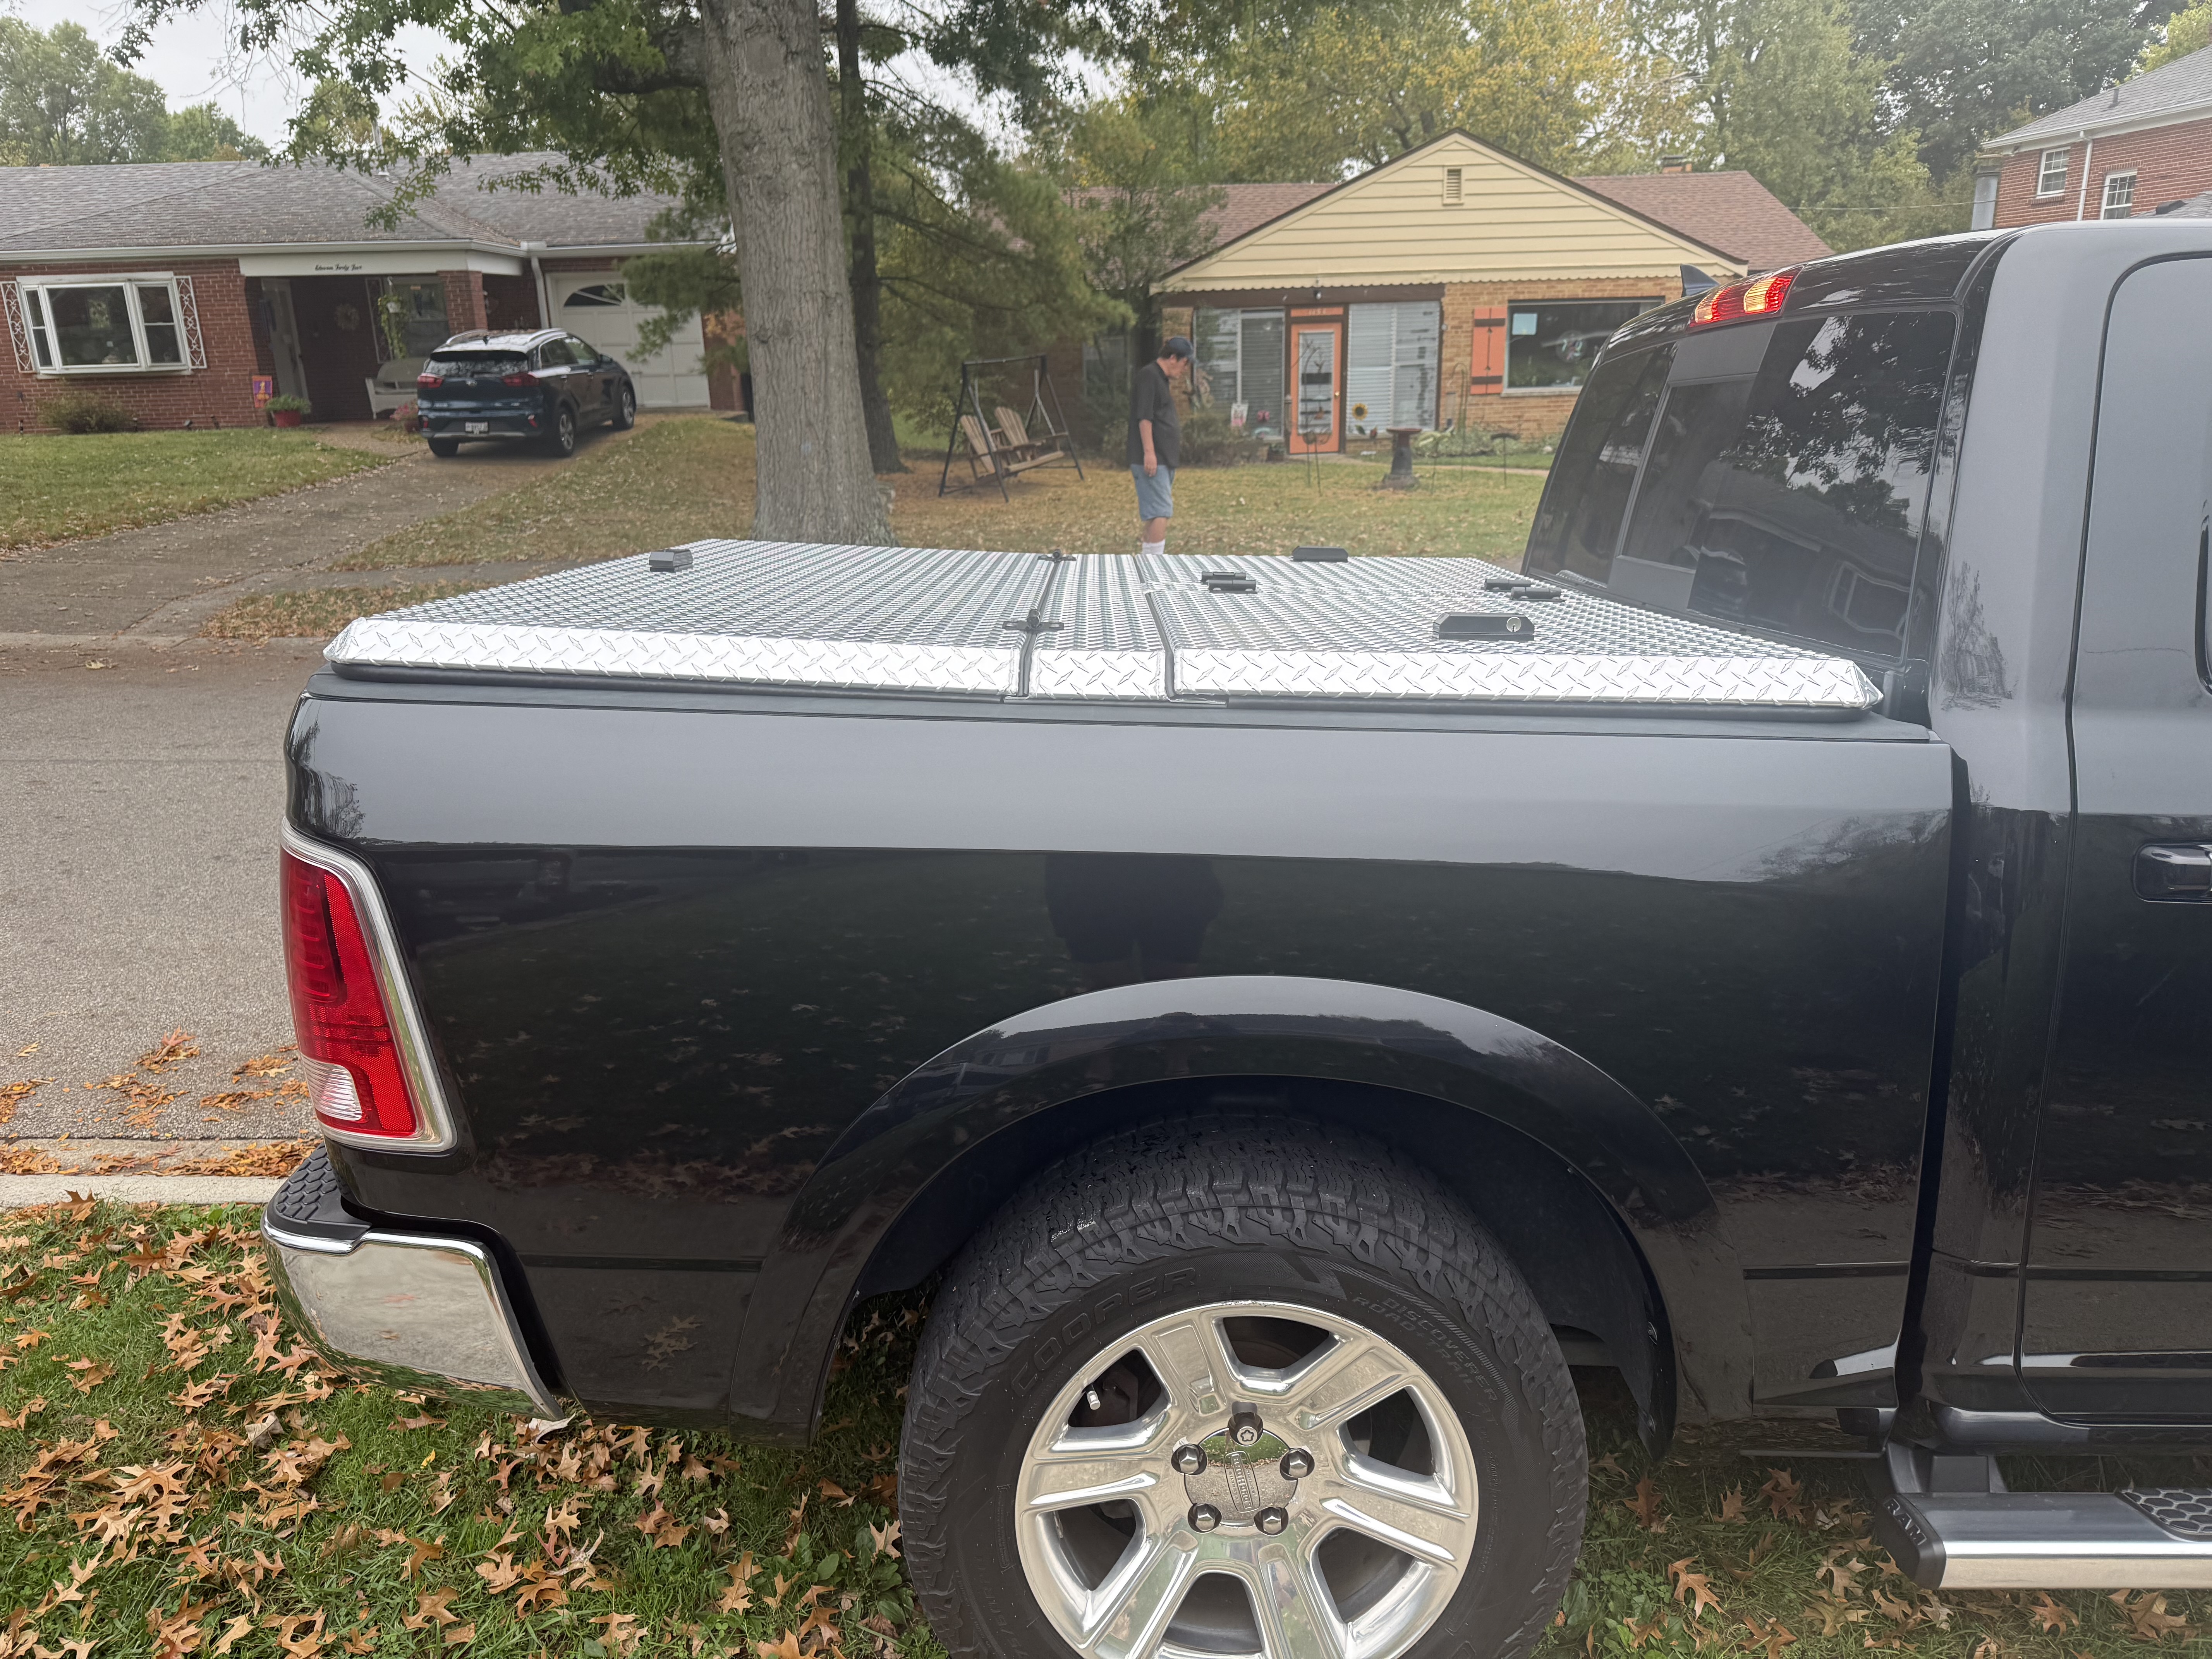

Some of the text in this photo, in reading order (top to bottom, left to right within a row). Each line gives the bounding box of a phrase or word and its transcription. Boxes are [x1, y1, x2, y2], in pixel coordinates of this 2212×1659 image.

[1012, 1267, 1196, 1395] COOPER
[1382, 1298, 1498, 1401] DISCOVERER
[1883, 1498, 1927, 1546] RAM
